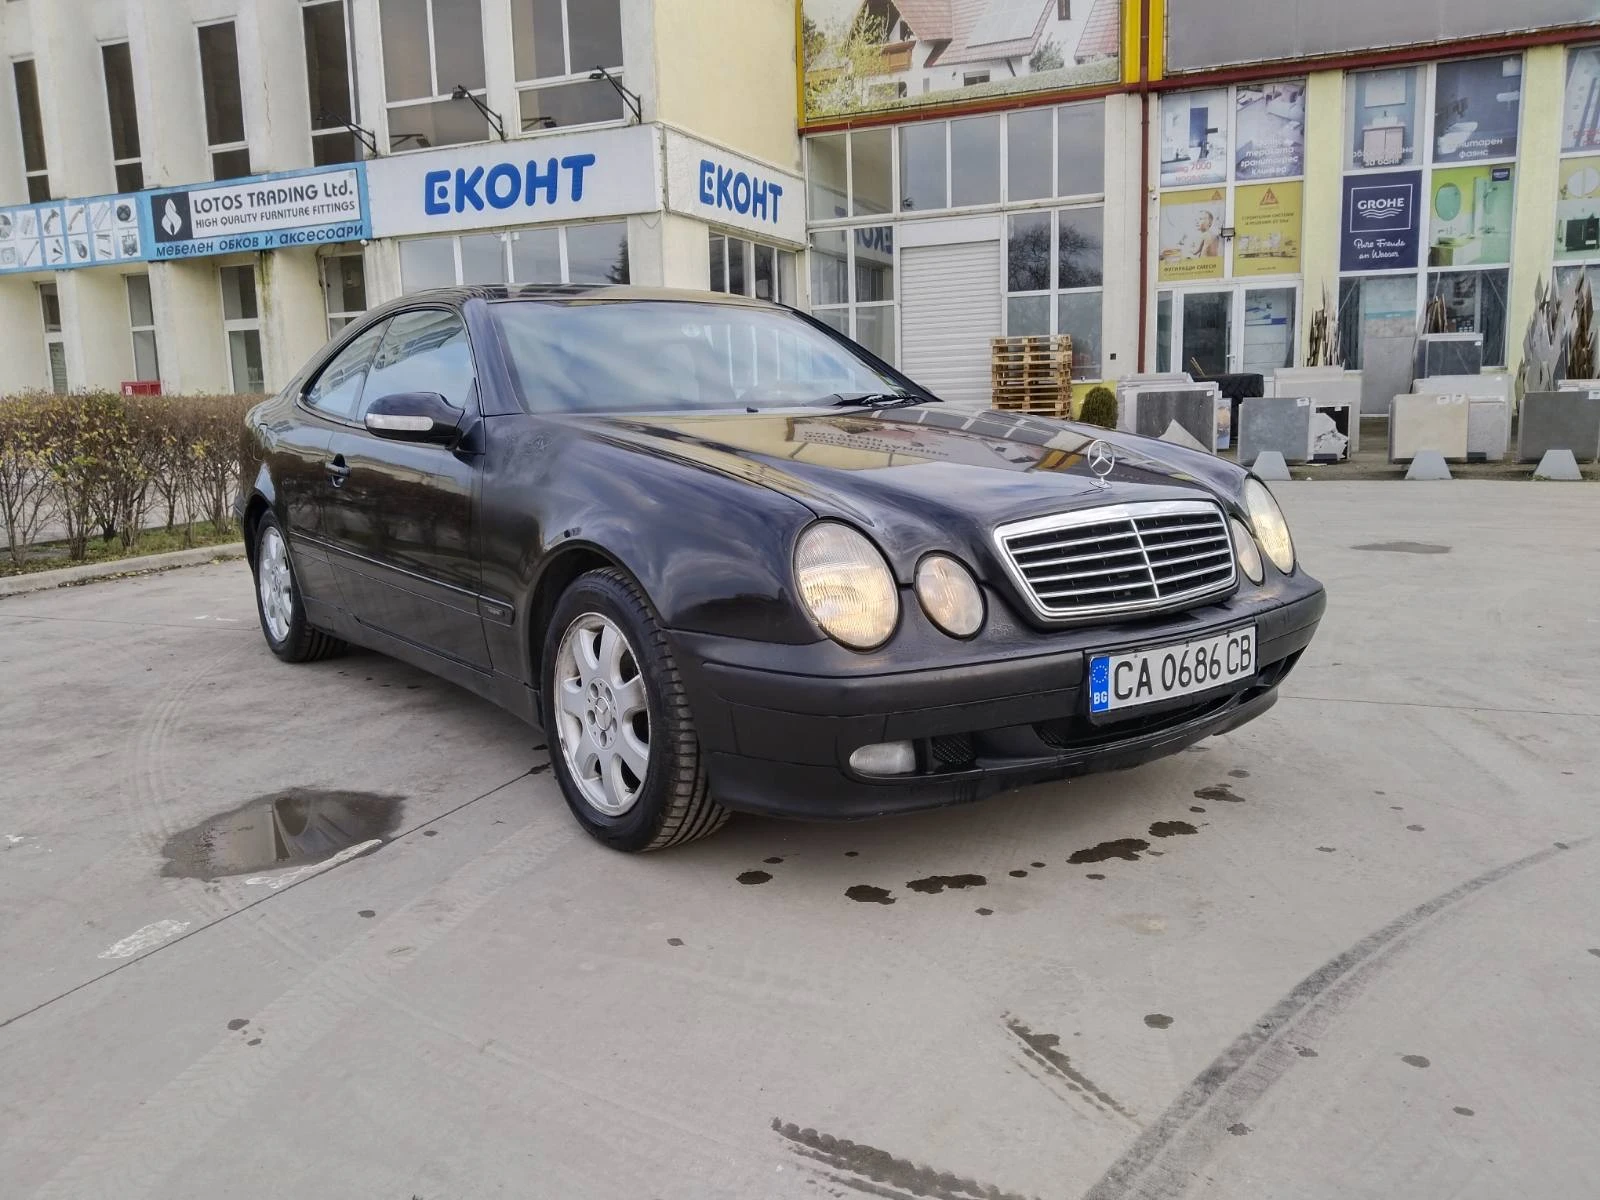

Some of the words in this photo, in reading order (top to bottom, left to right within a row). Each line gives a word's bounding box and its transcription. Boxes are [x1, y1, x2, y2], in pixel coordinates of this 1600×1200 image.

[194, 194, 243, 215] LOTOS
[247, 184, 318, 207] TRADING
[323, 180, 354, 198] Ltd.
[425, 153, 596, 216] ЕКОНТ
[699, 159, 783, 224] ЕКОНТ
[196, 218, 218, 229] HIGH
[220, 213, 258, 227] QUALITY
[260, 207, 310, 222] FURNITURE
[312, 201, 356, 217] FITTINGS
[1357, 197, 1405, 210] GROHE
[1114, 658, 1153, 700] CA
[1161, 643, 1221, 691] 0686
[1226, 634, 1252, 675] CB
[1093, 691, 1108, 704] BG
